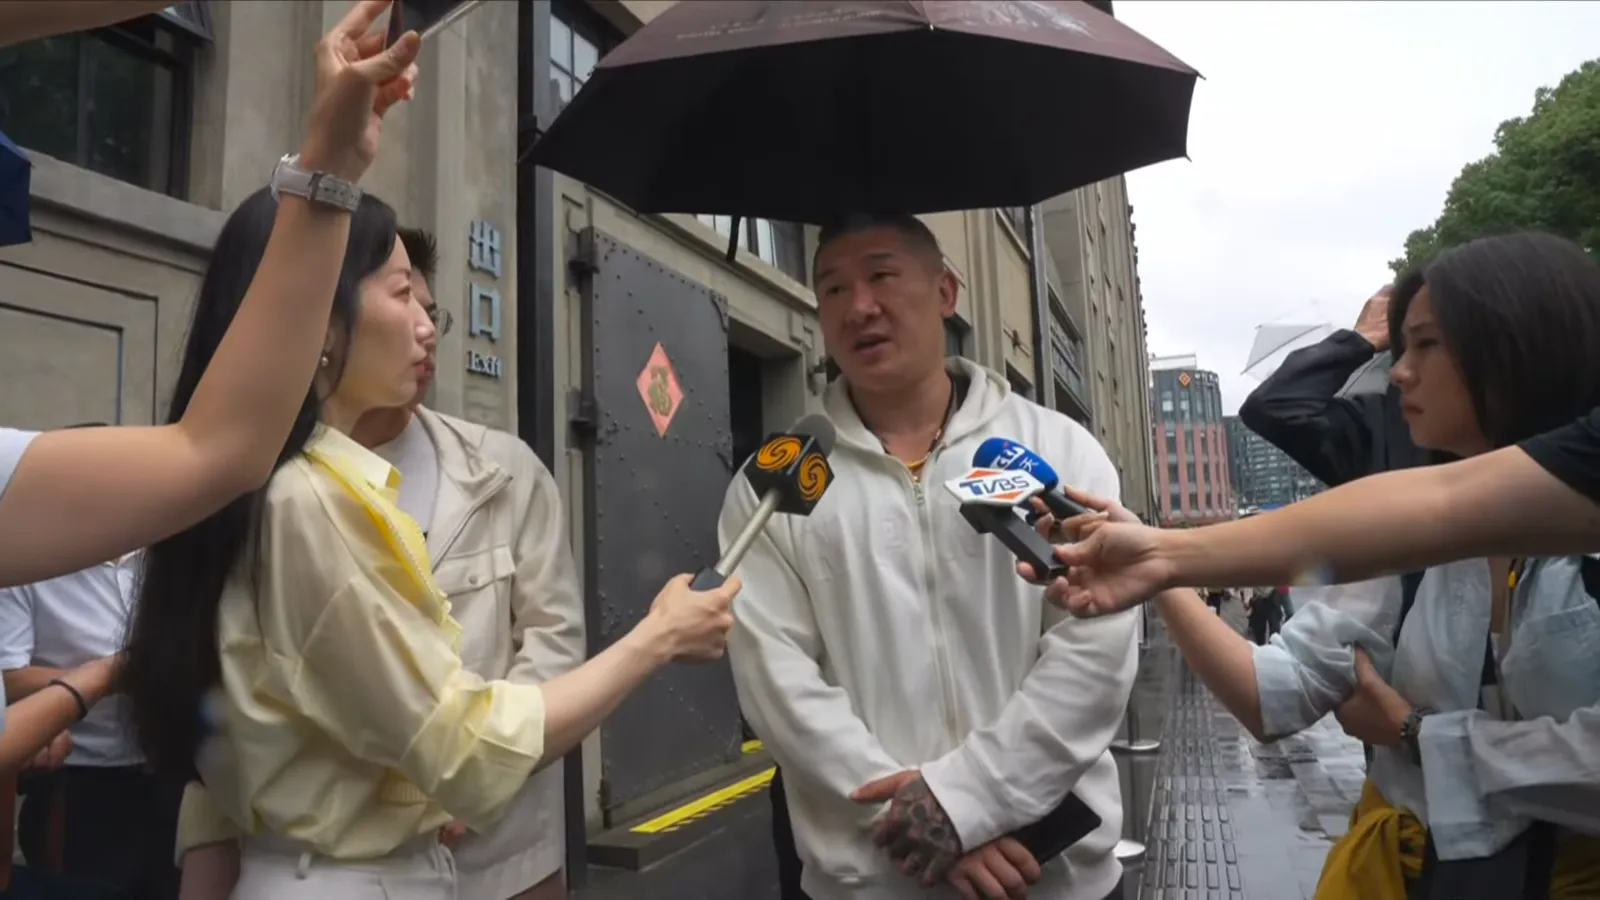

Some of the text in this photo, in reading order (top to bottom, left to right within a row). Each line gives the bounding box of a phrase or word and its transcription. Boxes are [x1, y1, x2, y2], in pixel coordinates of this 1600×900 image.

[468, 220, 502, 342] 出口
[467, 349, 502, 378] Exit
[959, 476, 1029, 496] TVBS
